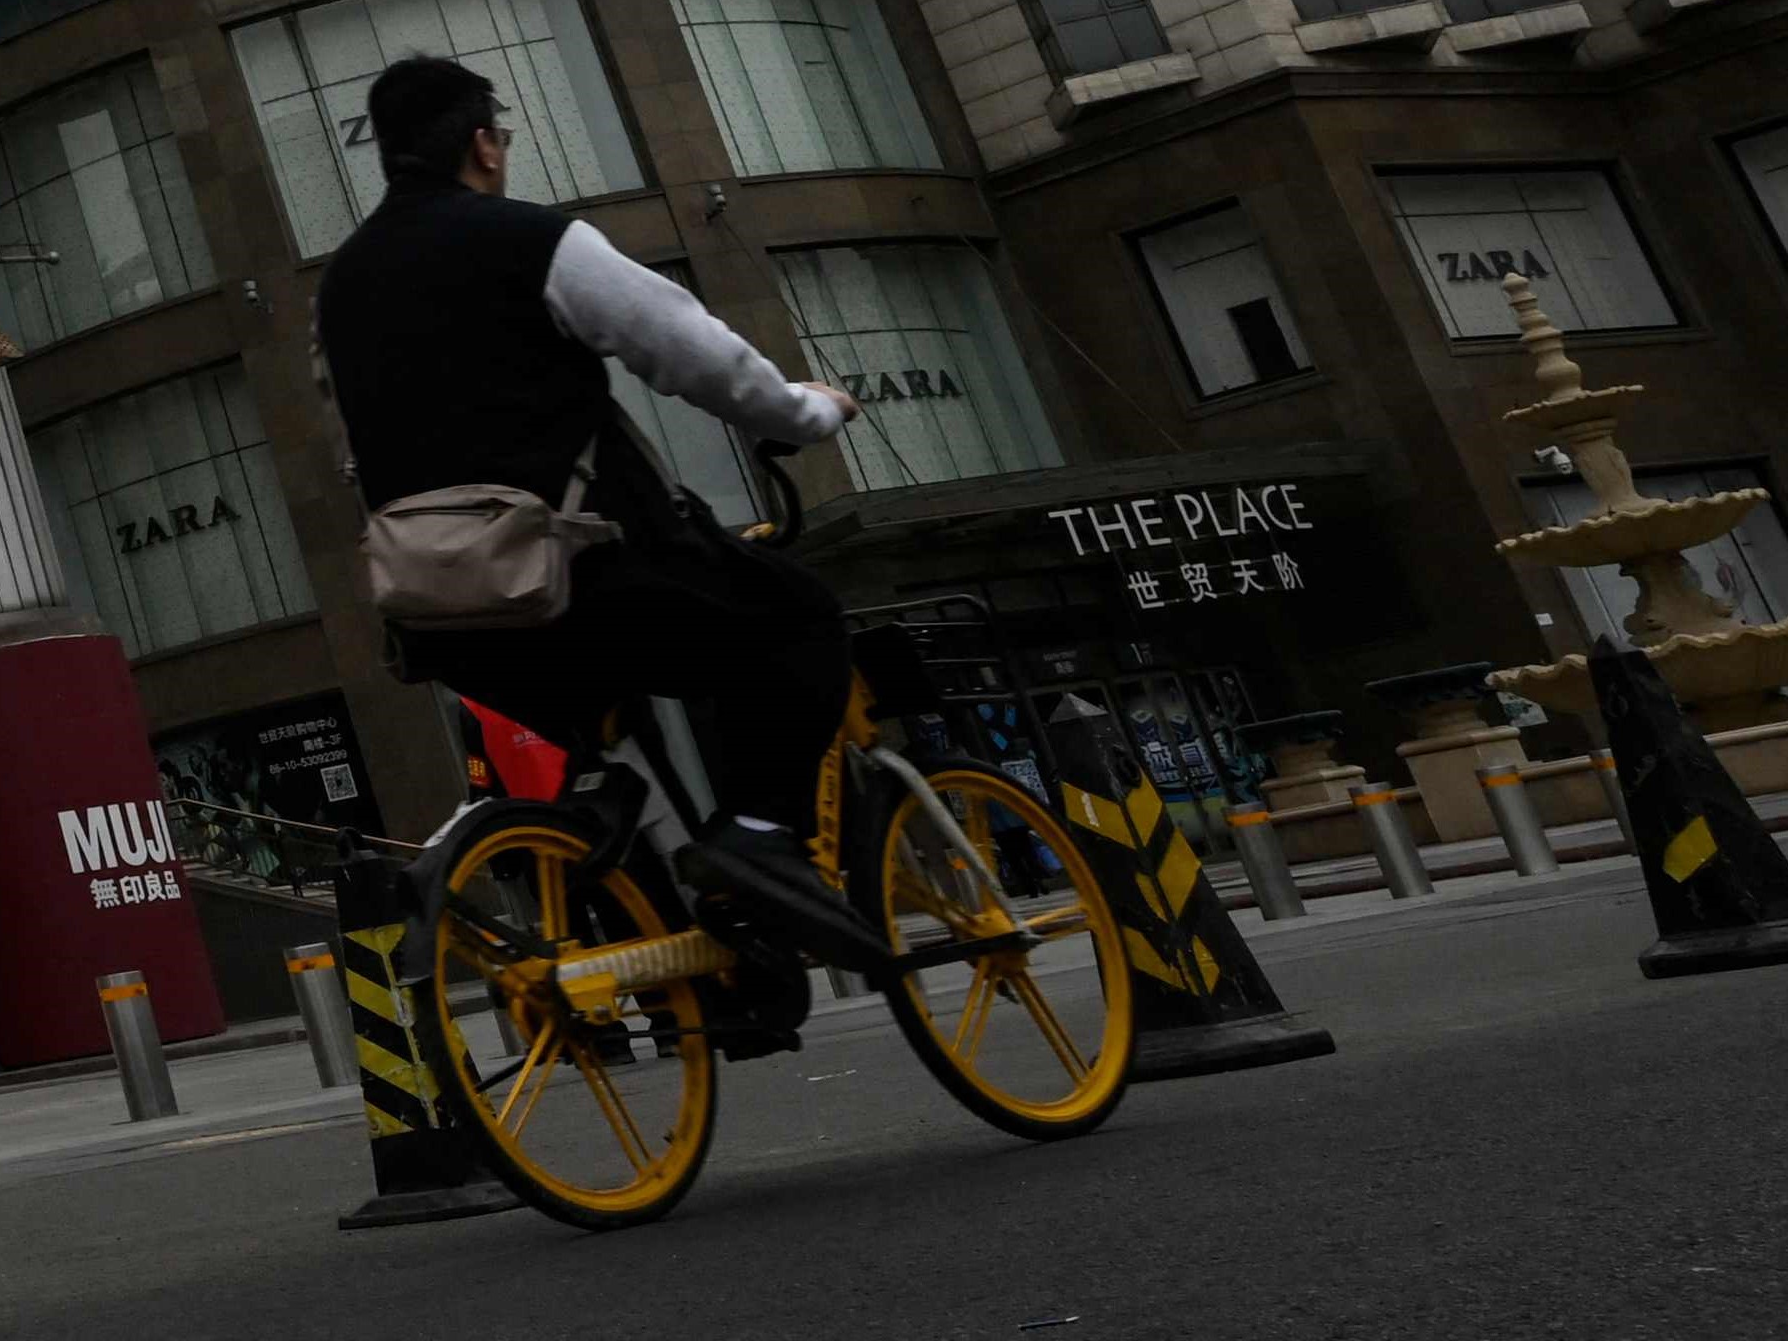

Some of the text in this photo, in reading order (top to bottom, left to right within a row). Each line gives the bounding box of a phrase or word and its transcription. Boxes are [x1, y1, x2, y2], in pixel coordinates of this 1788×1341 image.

[1437, 249, 1549, 282] ZARA
[841, 369, 963, 402] ZARA
[117, 496, 241, 554] ZARA
[1047, 483, 1314, 556] THE PLACE
[1127, 551, 1306, 611] 世贸天阶
[57, 799, 177, 874] MUJI
[90, 869, 182, 909] 無印良品
